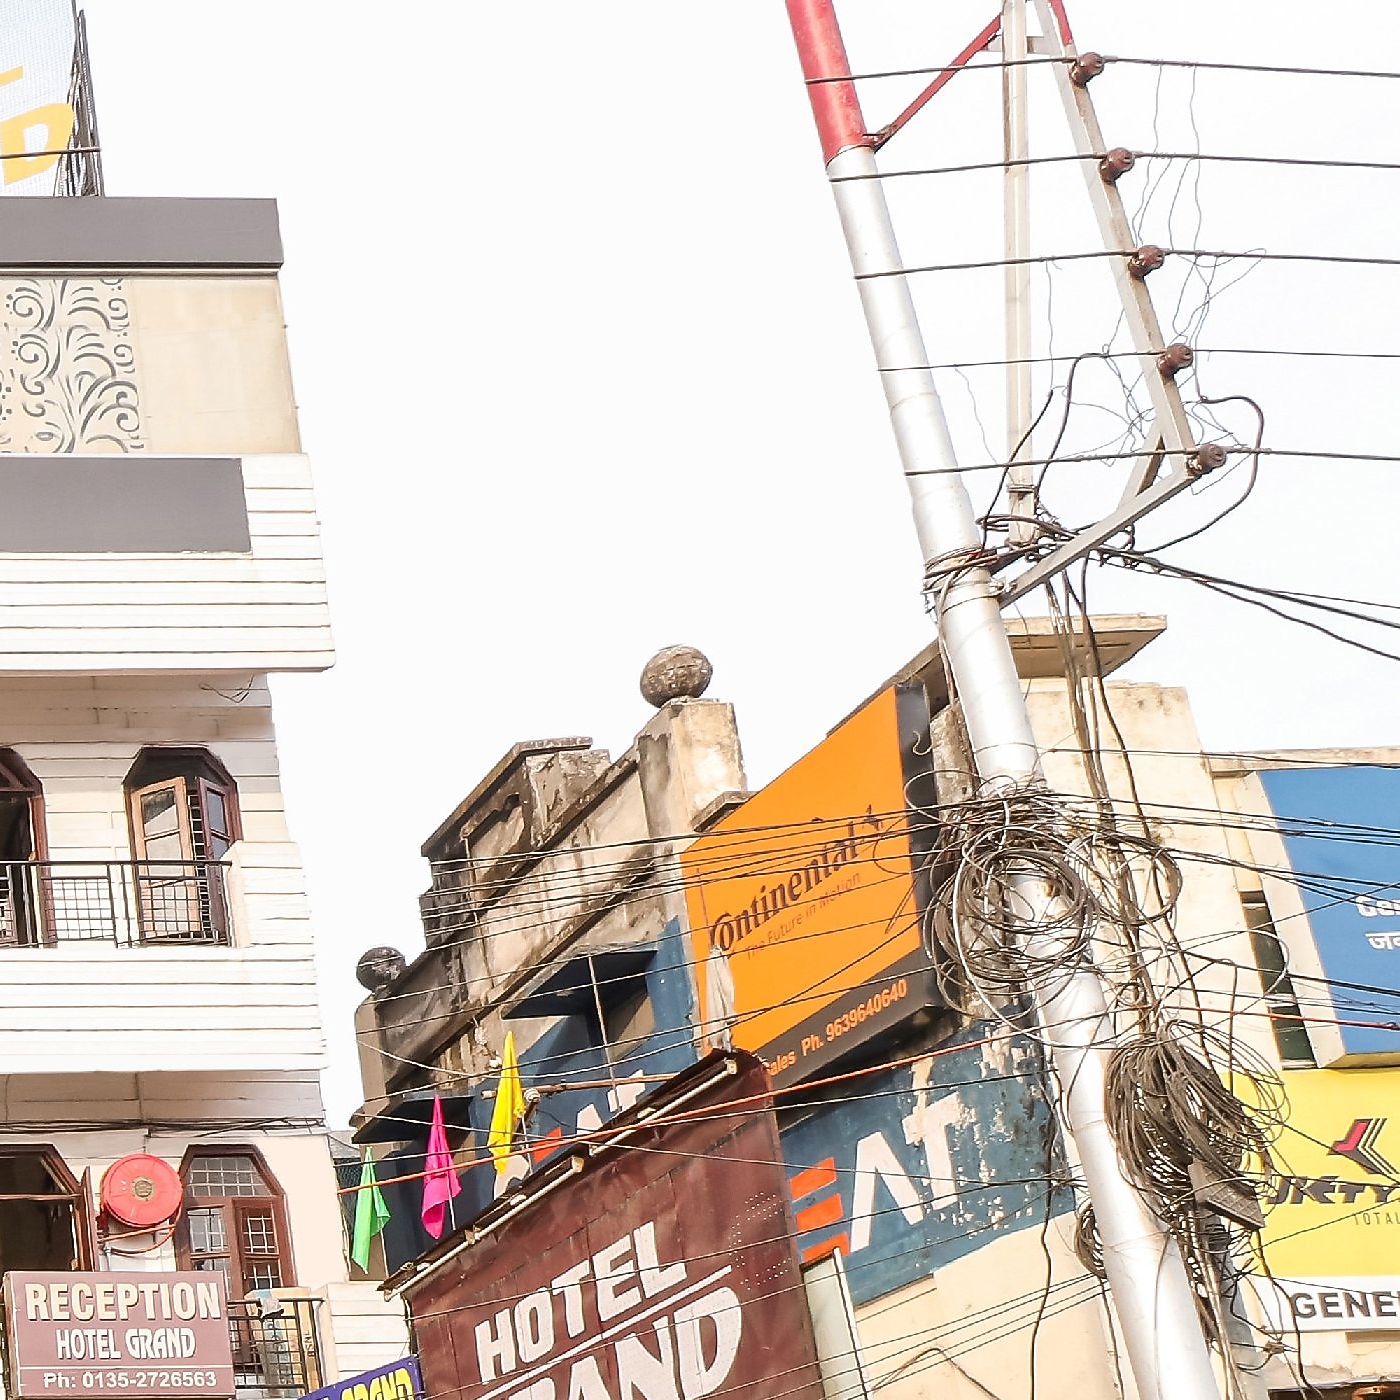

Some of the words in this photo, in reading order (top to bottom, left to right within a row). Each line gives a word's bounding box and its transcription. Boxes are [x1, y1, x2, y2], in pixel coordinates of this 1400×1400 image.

[25, 1282, 222, 1322] RECEPTION
[474, 1221, 689, 1386] HOTEL
[56, 1328, 122, 1360] HOTEL
[125, 1328, 197, 1360] GRAND
[43, 1372, 77, 1389] Ph:
[82, 1371, 218, 1388] 0135-2726563
